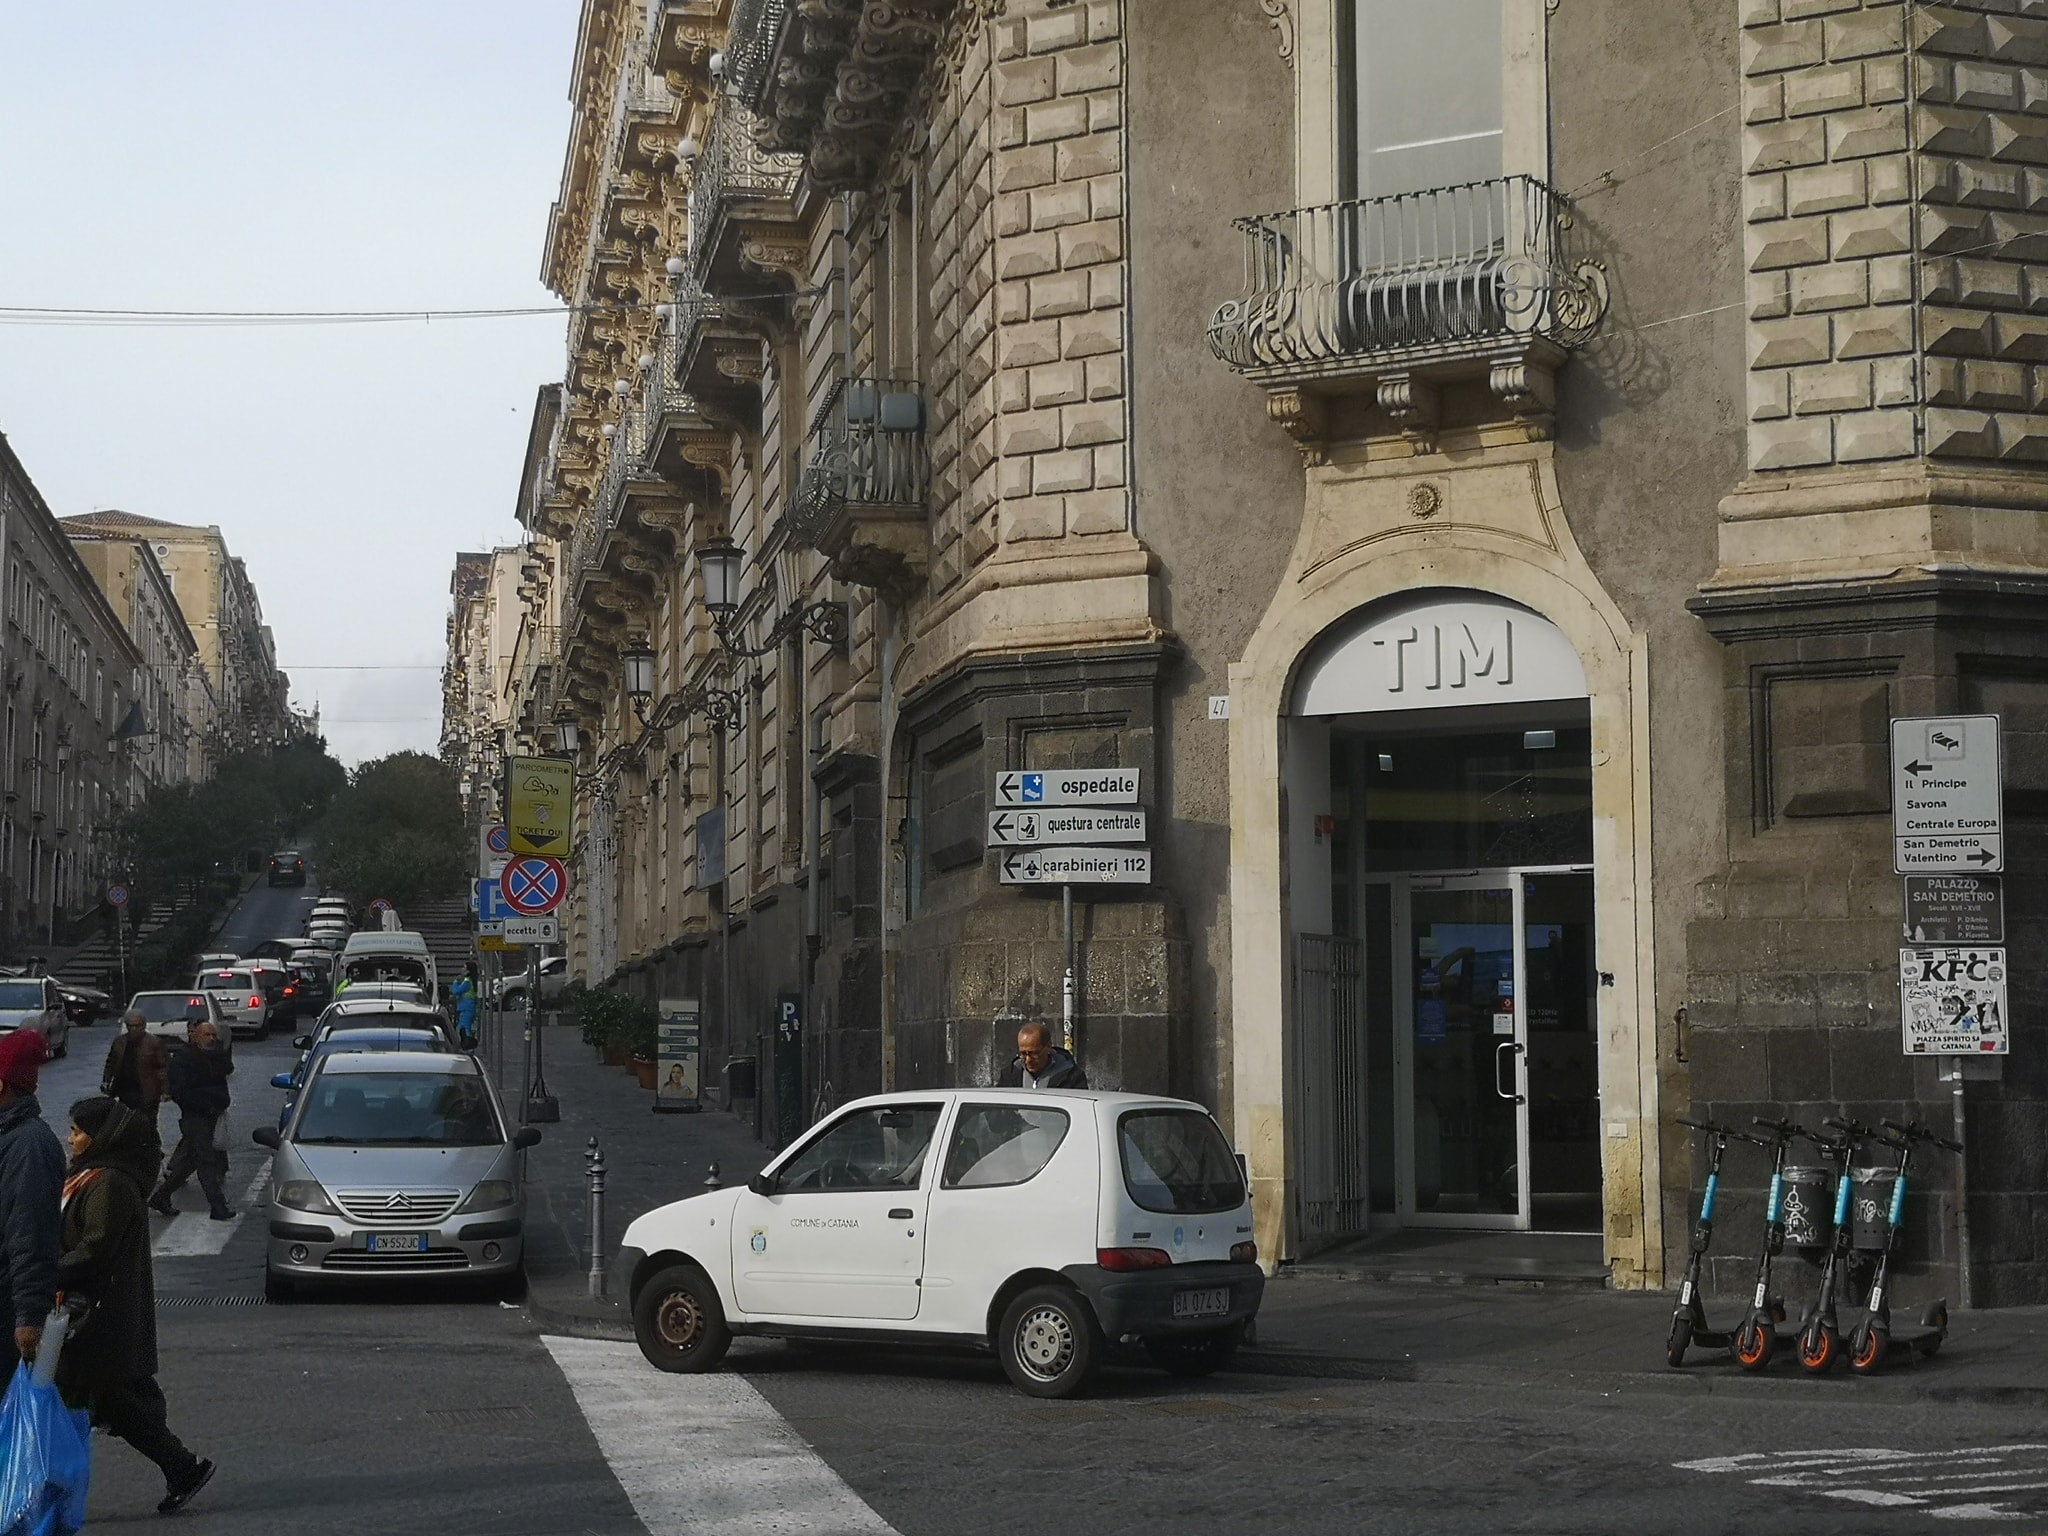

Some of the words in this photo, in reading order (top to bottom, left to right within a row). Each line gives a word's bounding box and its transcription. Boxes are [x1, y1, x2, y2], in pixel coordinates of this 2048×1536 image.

[1372, 619, 1513, 693] TIM
[515, 763, 570, 775] PARCOMETRO
[1061, 777, 1134, 796] ospedale
[1922, 779, 1967, 789] Principe
[1906, 800, 1947, 809] Savona
[1048, 817, 1093, 833] questura
[1096, 815, 1141, 830] centrale
[1906, 820, 1954, 829] Centrale
[1957, 819, 1997, 829] Europa
[516, 826, 545, 835] TICKET
[548, 829, 563, 837] QUI
[1903, 839, 1925, 849] San
[1929, 838, 1980, 849] Demetrio
[1904, 854, 1957, 863] Valentino
[1043, 858, 1118, 872] carabinieri
[1124, 858, 1146, 872] 112
[1928, 879, 1979, 889] PALAZZO
[1913, 891, 1937, 902] SAN
[1941, 891, 1995, 902] DEMETRIO
[507, 926, 537, 935] eccetto
[1920, 960, 1987, 981] KFC
[783, 1002, 796, 1021] P
[790, 1218, 820, 1228] COMUNE
[828, 1218, 860, 1228] CATANIA
